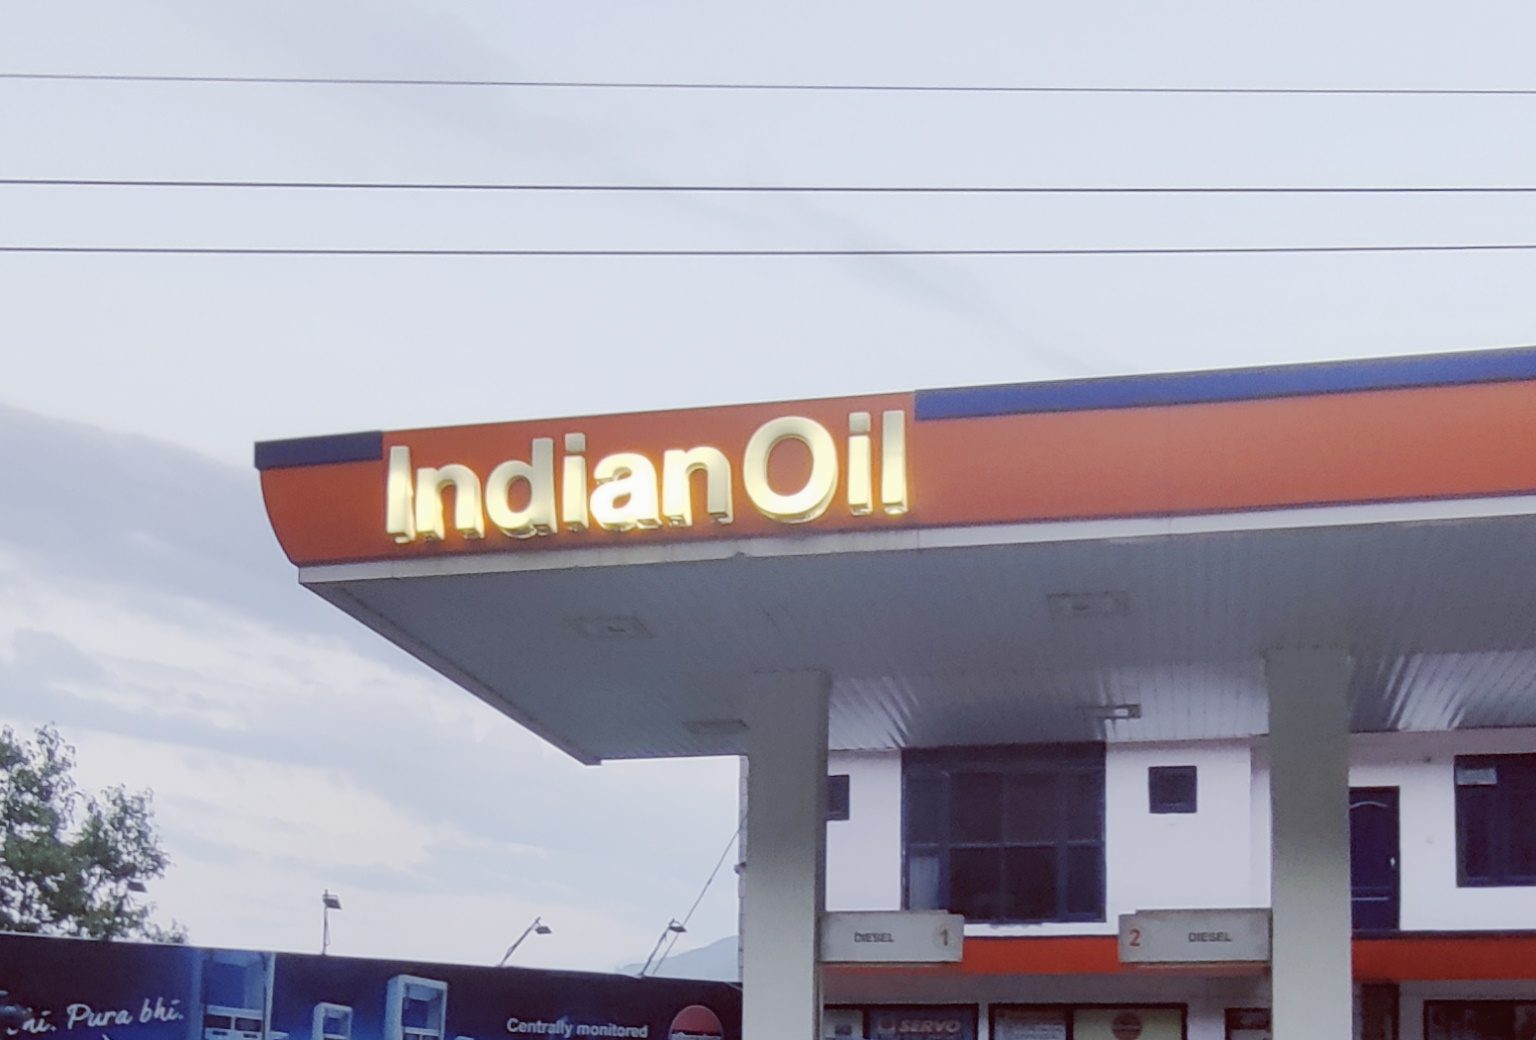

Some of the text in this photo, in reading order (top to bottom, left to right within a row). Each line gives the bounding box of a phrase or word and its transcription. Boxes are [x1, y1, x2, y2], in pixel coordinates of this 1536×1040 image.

[386, 410, 907, 543] IndianOil
[854, 932, 894, 943] DIESEL
[941, 928, 949, 946] 1
[1129, 929, 1141, 947] 2
[1188, 931, 1231, 943] DIESEL
[66, 1003, 133, 1030] Pura
[139, 997, 184, 1023] bhi.
[506, 1017, 648, 1039] Centrally monitored
[899, 1018, 961, 1033] SERVO
